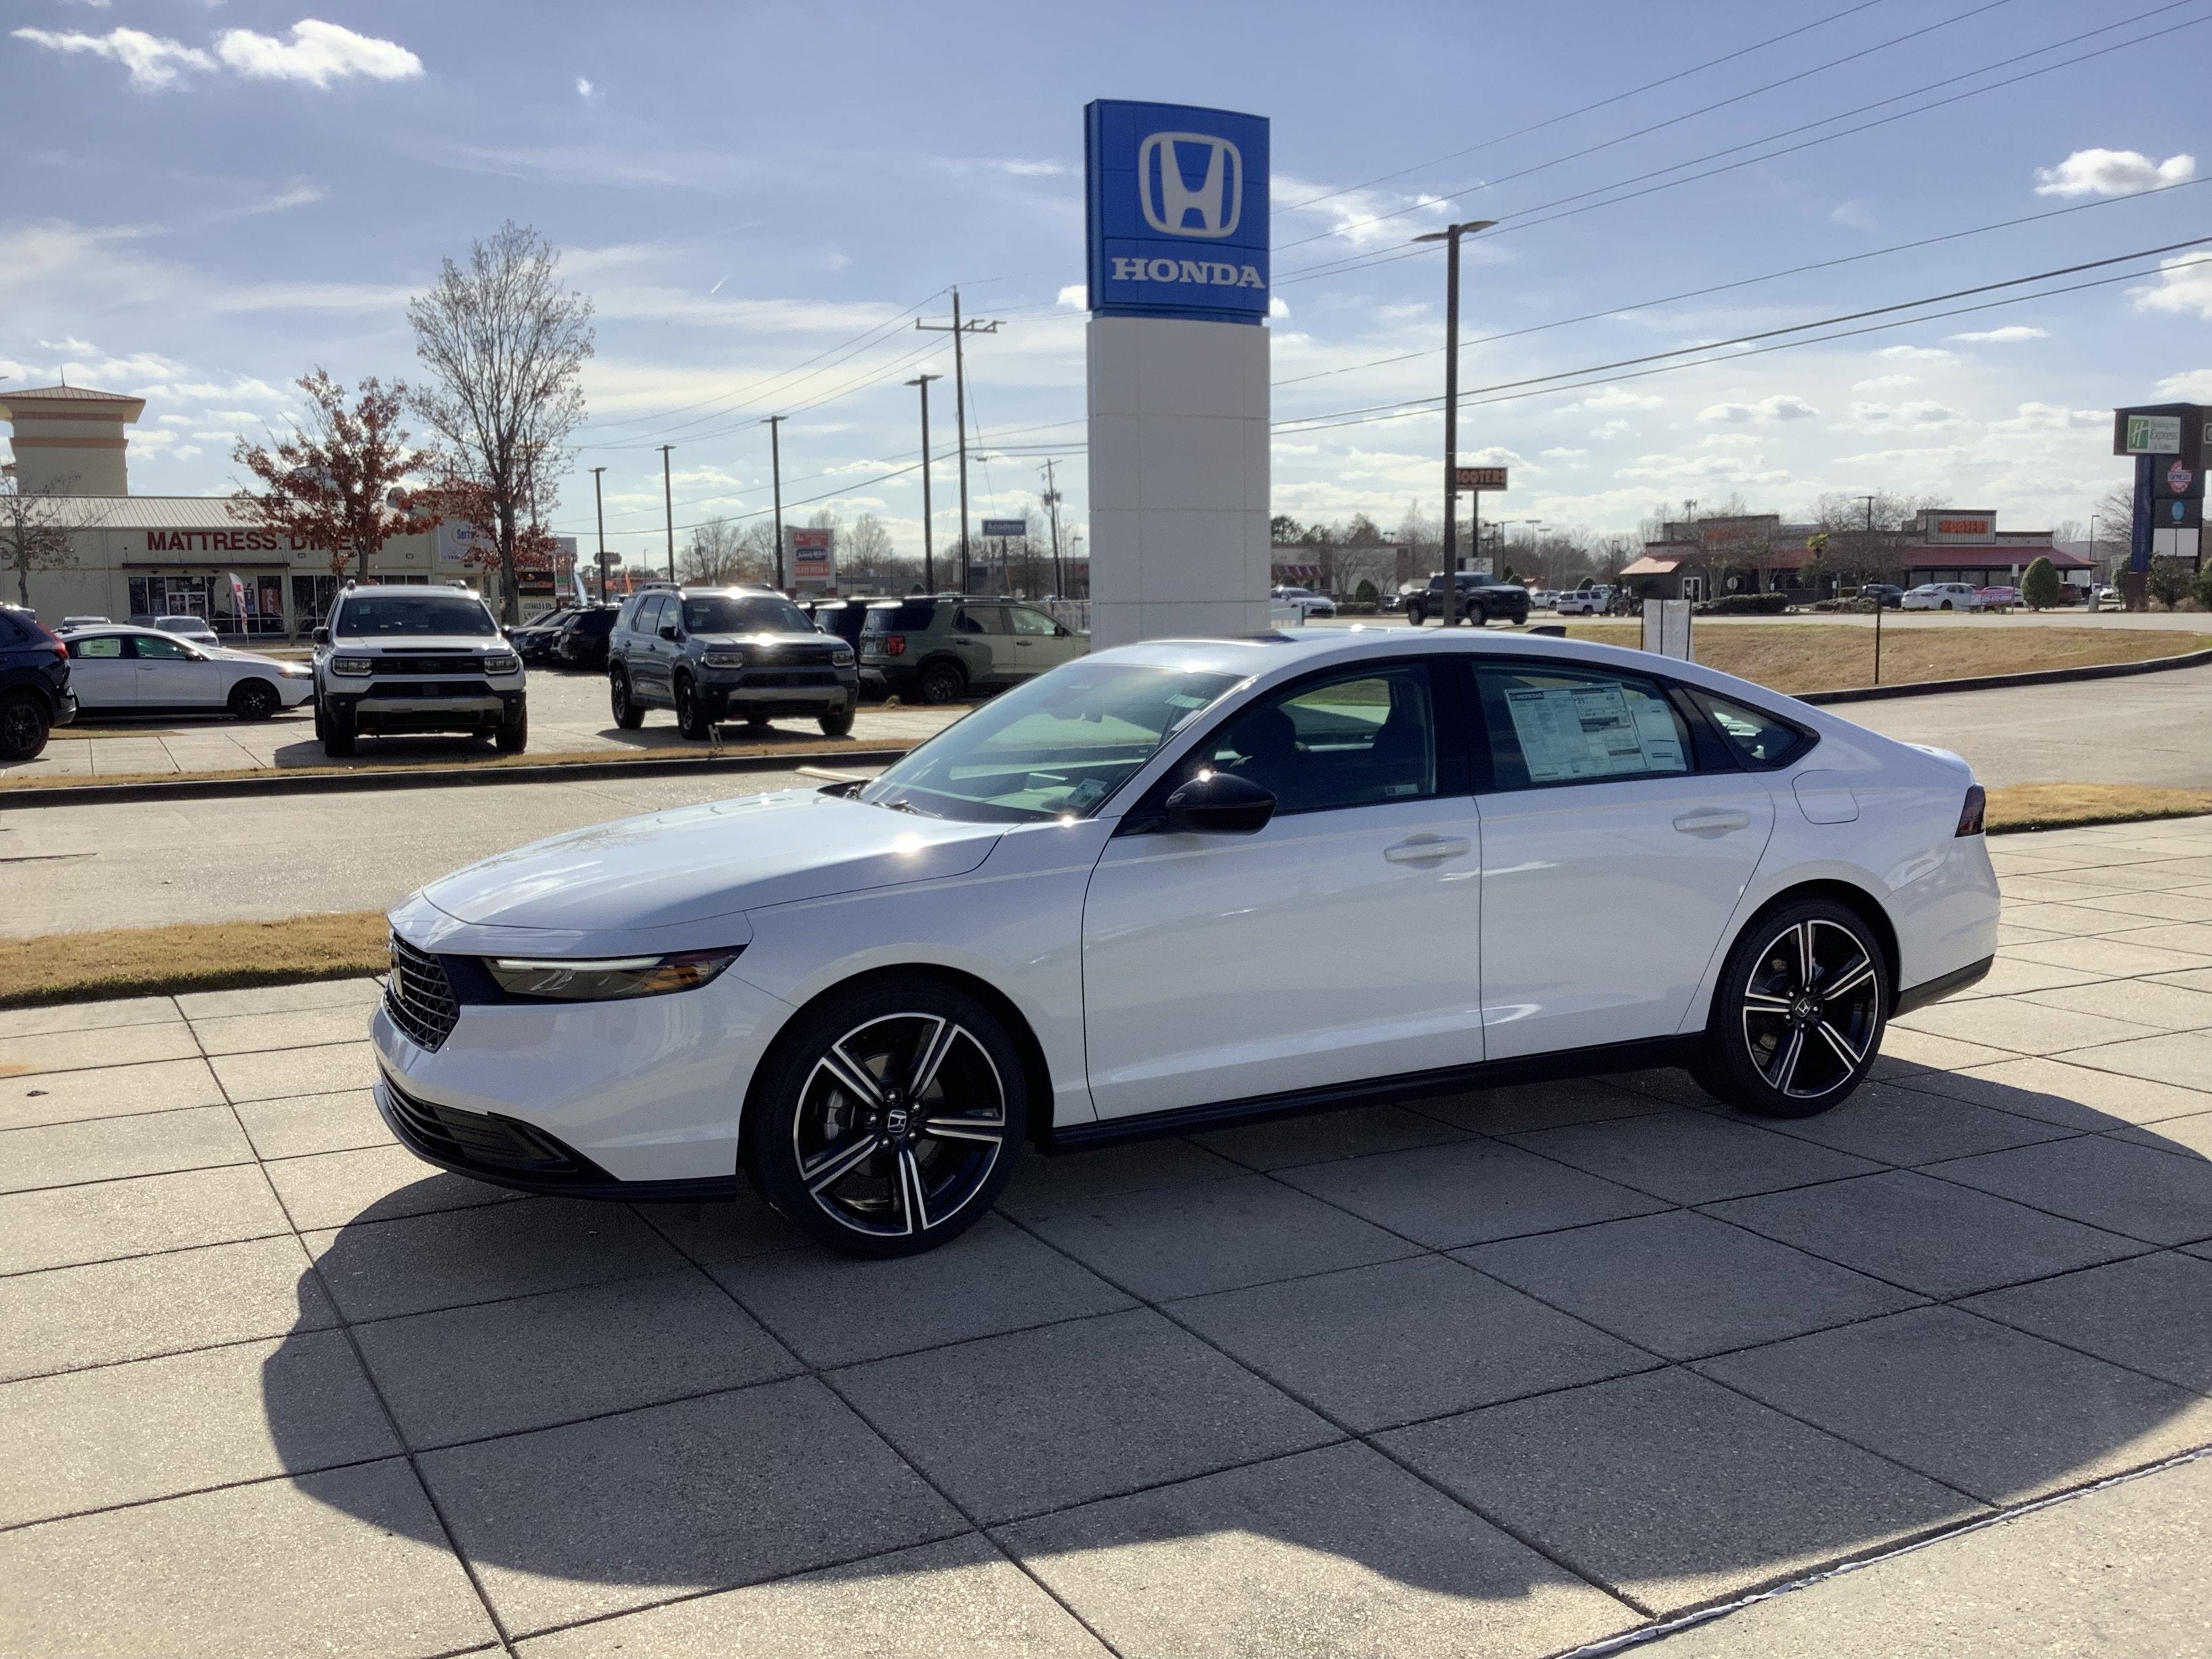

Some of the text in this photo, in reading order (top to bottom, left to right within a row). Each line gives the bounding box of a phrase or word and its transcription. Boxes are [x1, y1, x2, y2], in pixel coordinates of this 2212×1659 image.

[1112, 258, 1265, 289] HONDA
[2150, 428, 2178, 441] Express
[1456, 470, 1506, 484] OOTERS
[987, 522, 1024, 532] Academy
[147, 531, 277, 551] MATTRESS
